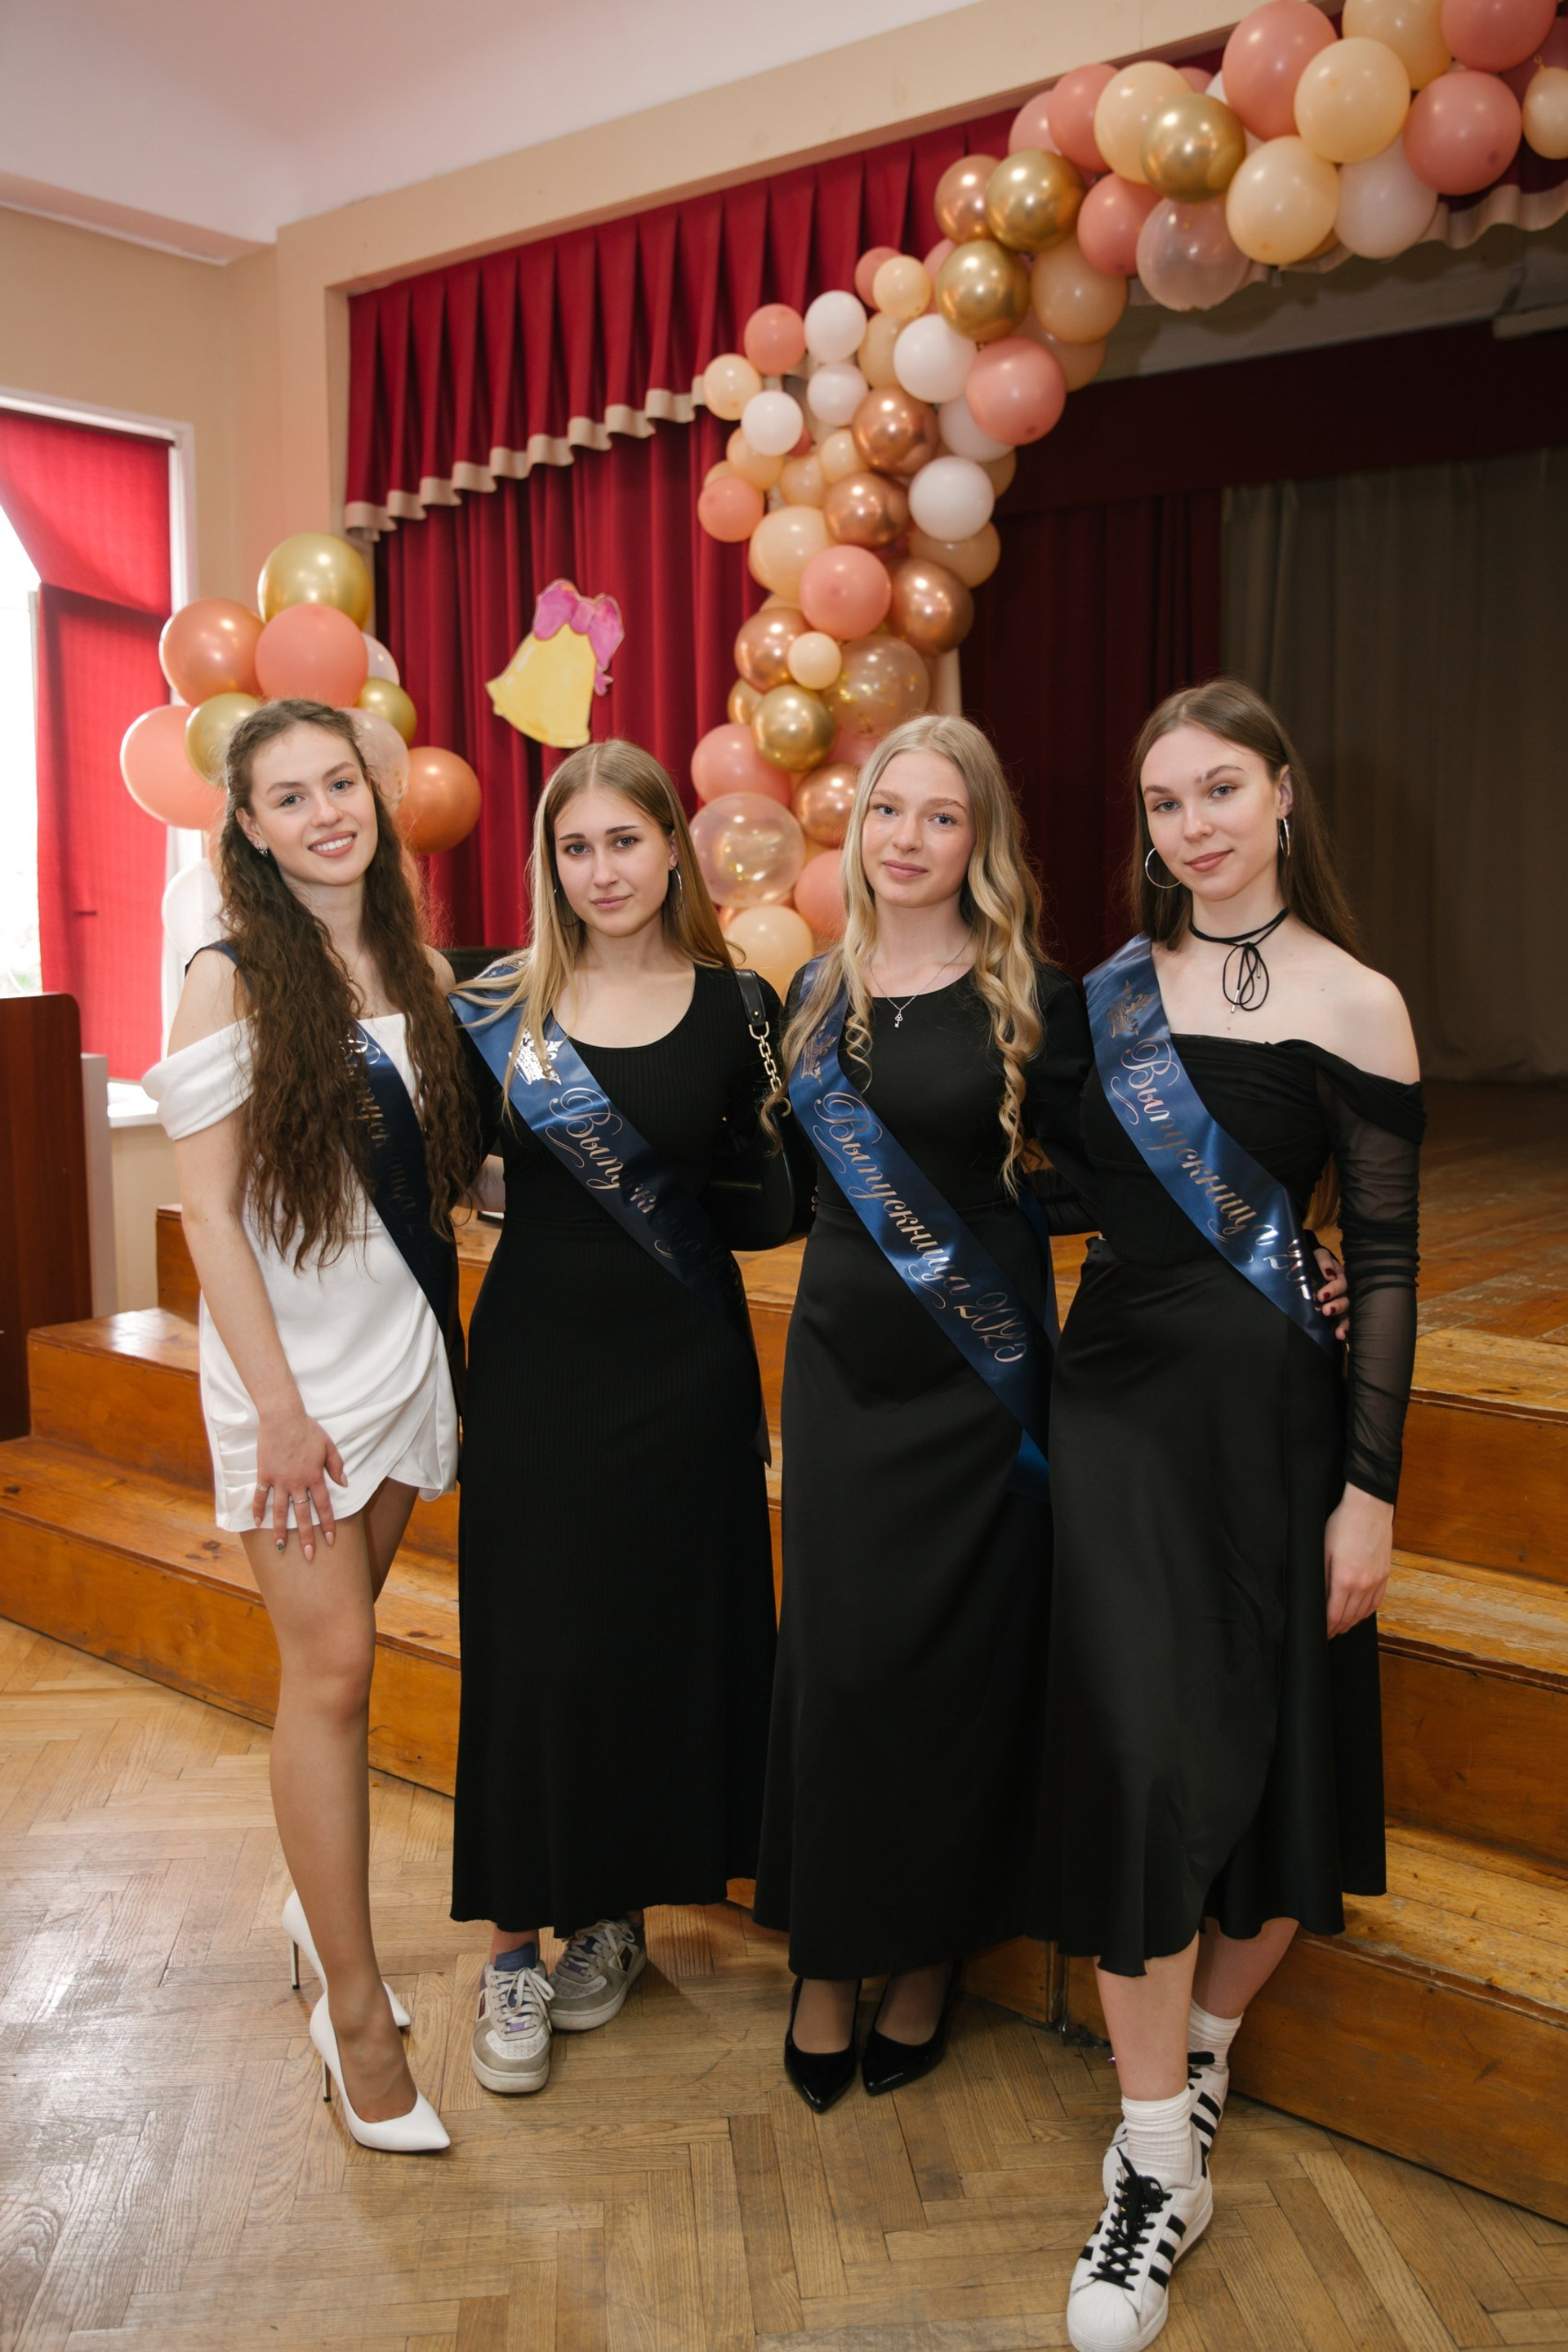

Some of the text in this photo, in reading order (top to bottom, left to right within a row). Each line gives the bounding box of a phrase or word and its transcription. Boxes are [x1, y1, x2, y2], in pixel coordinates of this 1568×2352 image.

[812, 1091, 1028, 1363] Выпускница 2025
[1111, 1037, 1278, 1246] Выпускница
